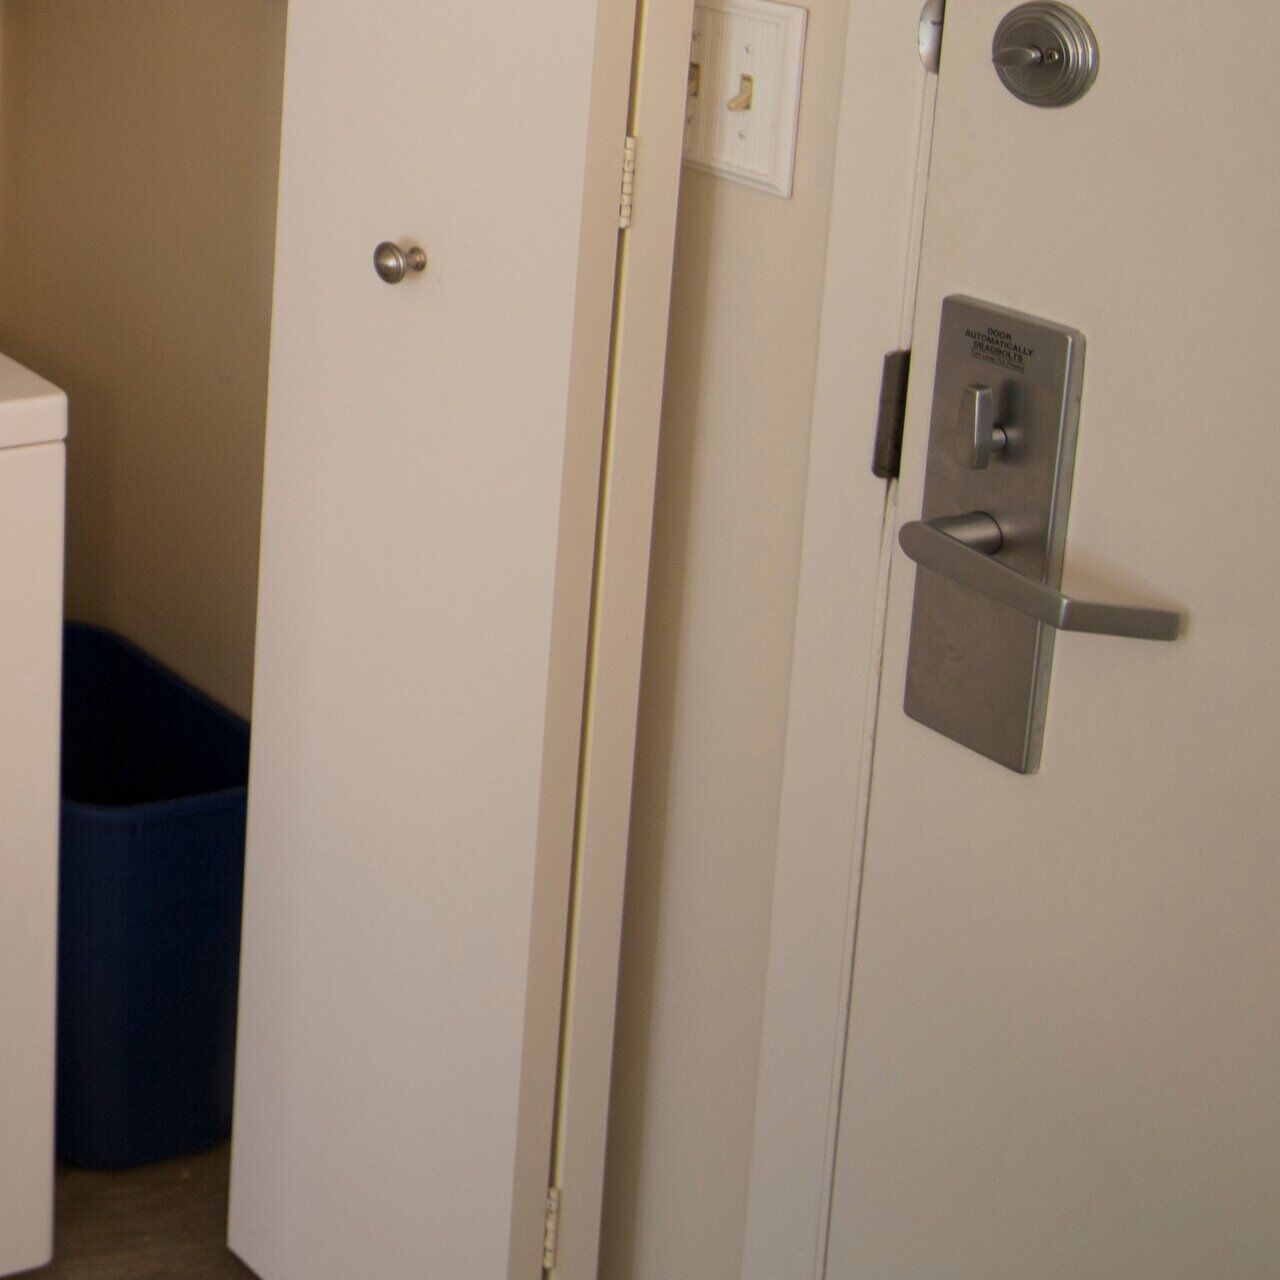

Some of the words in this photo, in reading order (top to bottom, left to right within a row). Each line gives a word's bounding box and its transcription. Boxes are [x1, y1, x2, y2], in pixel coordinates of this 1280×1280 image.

[965, 328, 1034, 357] AUTOMATICALLY
[987, 327, 1012, 342] DOOR
[973, 340, 1023, 362] DEADBOLTS
